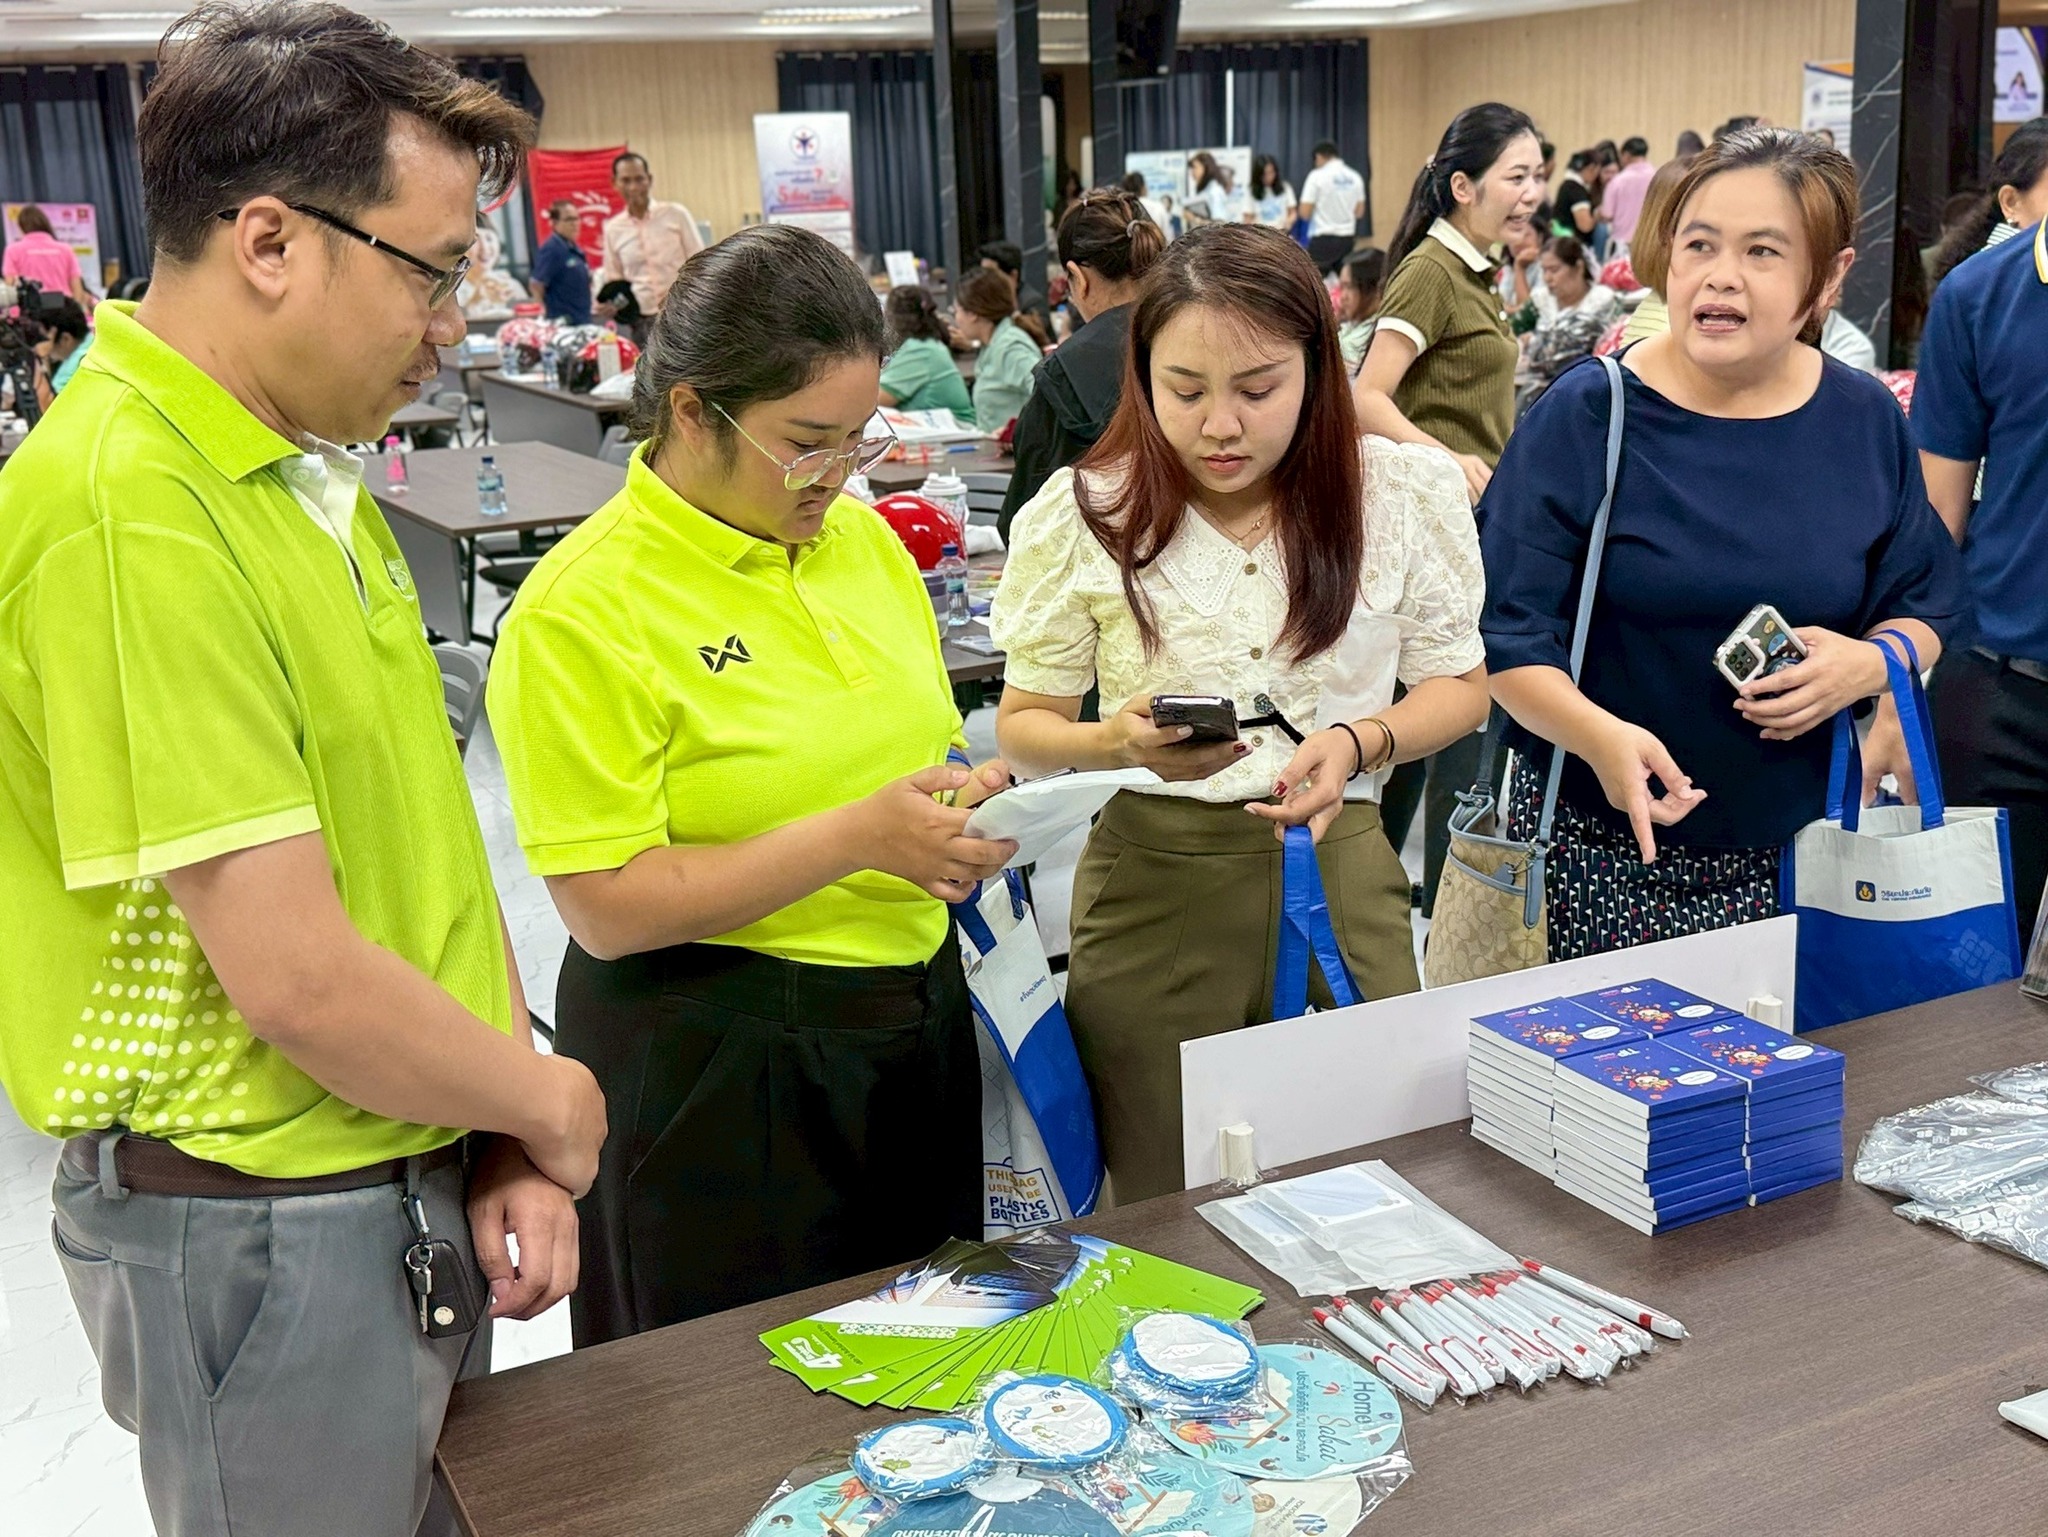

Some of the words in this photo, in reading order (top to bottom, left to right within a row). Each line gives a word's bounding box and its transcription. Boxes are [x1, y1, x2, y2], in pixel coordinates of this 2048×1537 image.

[1026, 1188, 1041, 1199] BE
[990, 1196, 1047, 1213] PLASTIC
[991, 1207, 1050, 1223] BOTTLES
[1353, 1380, 1376, 1424] Home
[1316, 1414, 1352, 1463] Sabai
